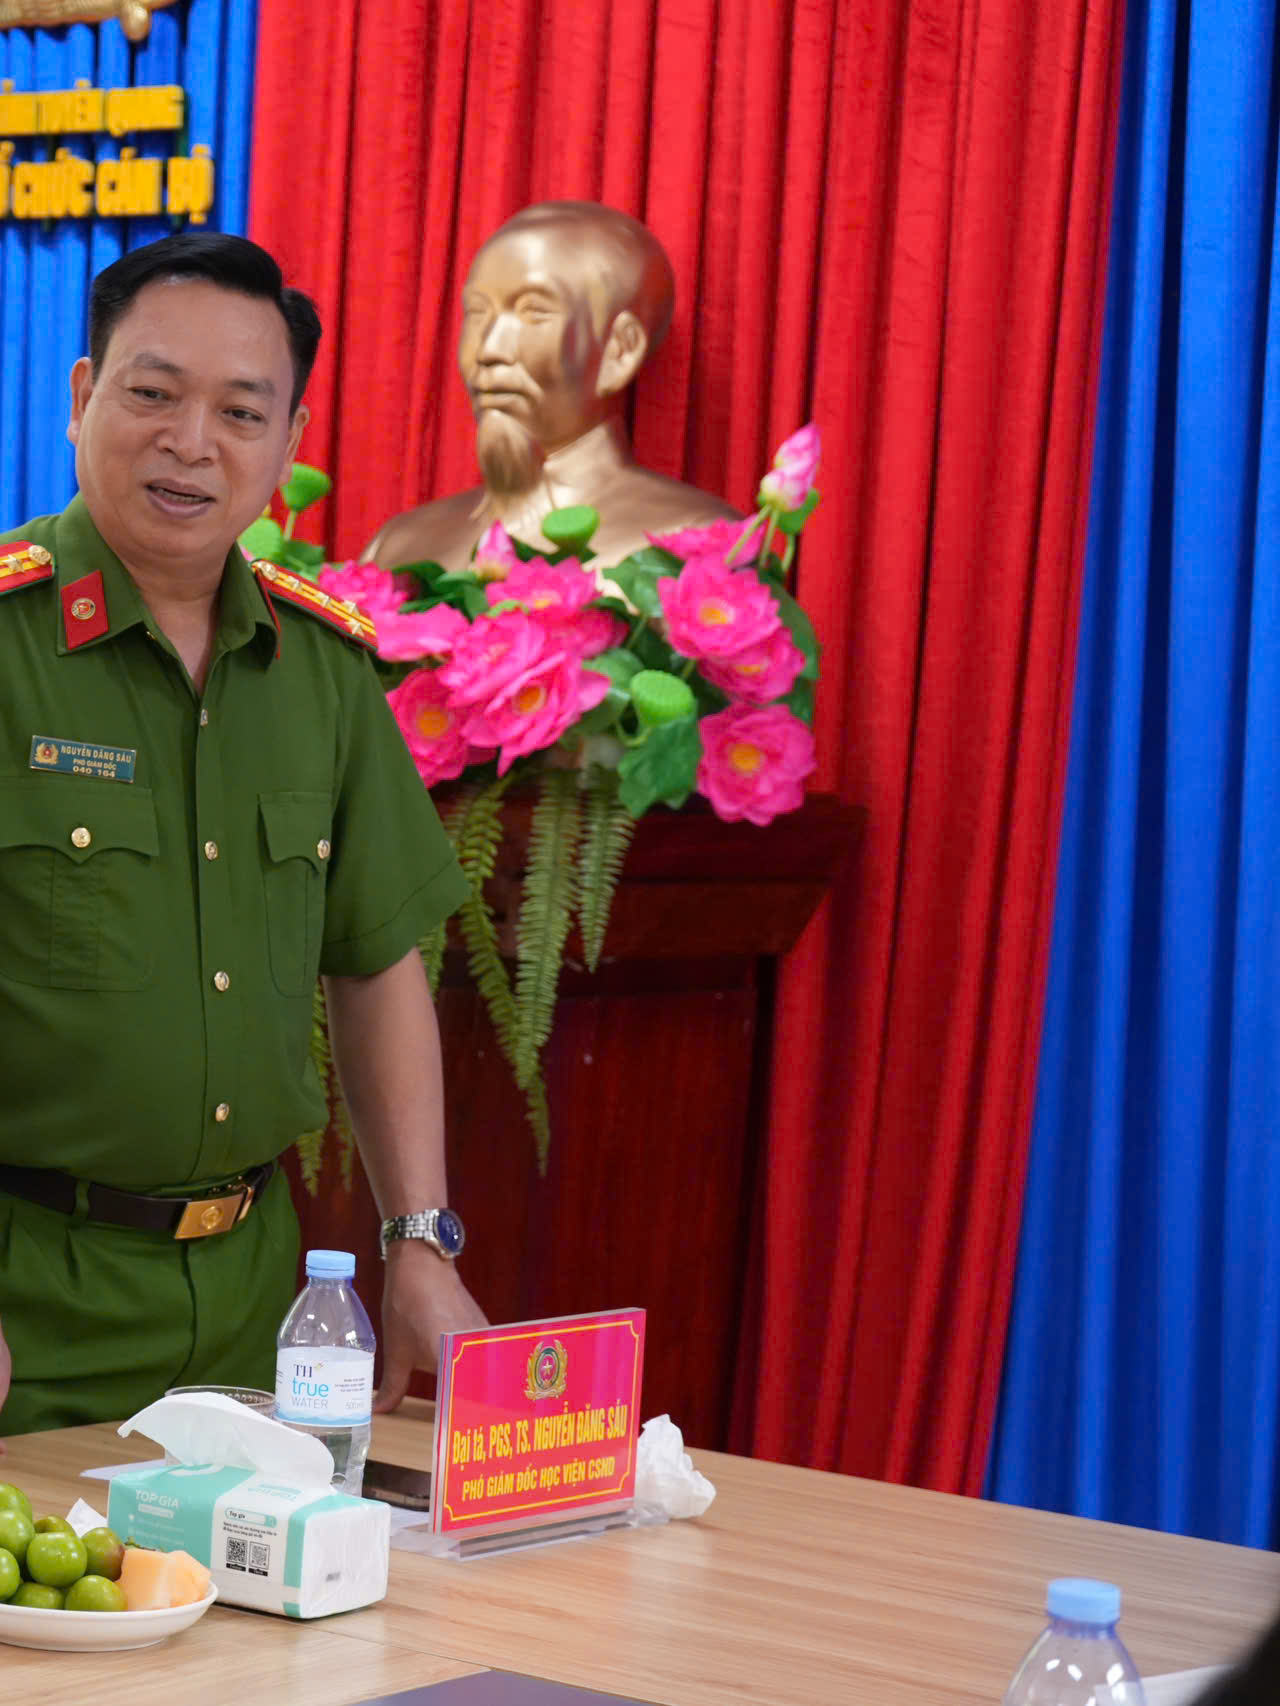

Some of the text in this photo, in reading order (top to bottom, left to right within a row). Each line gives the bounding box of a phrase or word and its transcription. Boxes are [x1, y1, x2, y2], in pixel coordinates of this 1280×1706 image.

[293, 1364, 313, 1378] TH
[292, 1376, 330, 1398] true
[291, 1397, 329, 1410] WATER
[452, 1428, 471, 1472] Đại
[488, 1421, 513, 1460] PGS,
[516, 1418, 531, 1455] TS.
[534, 1401, 576, 1452] NGUYỄN
[607, 1398, 628, 1440] SÁU
[462, 1455, 616, 1502] PHÓ GIÁM ĐỐC HỌC VIỆN CSND
